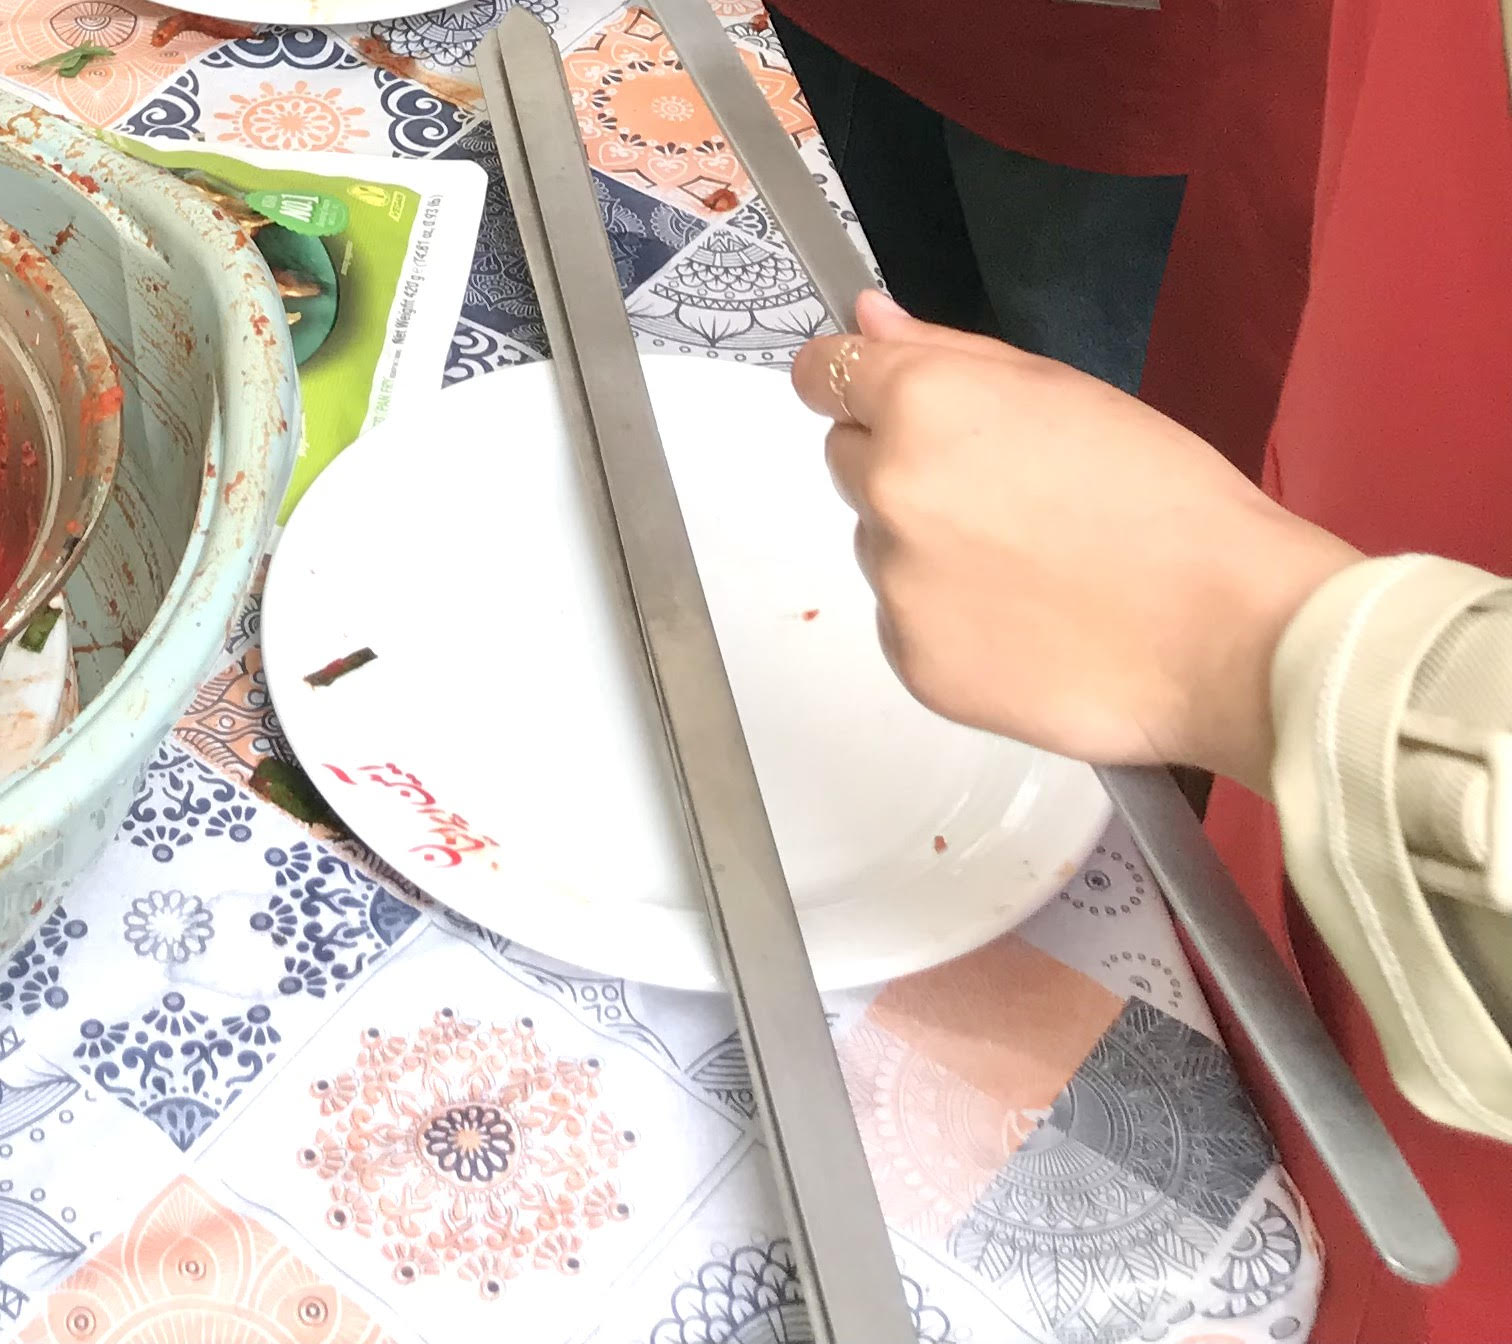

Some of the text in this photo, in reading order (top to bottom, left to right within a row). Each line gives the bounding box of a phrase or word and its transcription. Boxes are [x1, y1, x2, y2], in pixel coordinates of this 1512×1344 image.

[404, 280, 419, 298] 420
[395, 299, 416, 328] Weight
[392, 330, 407, 344] Net
